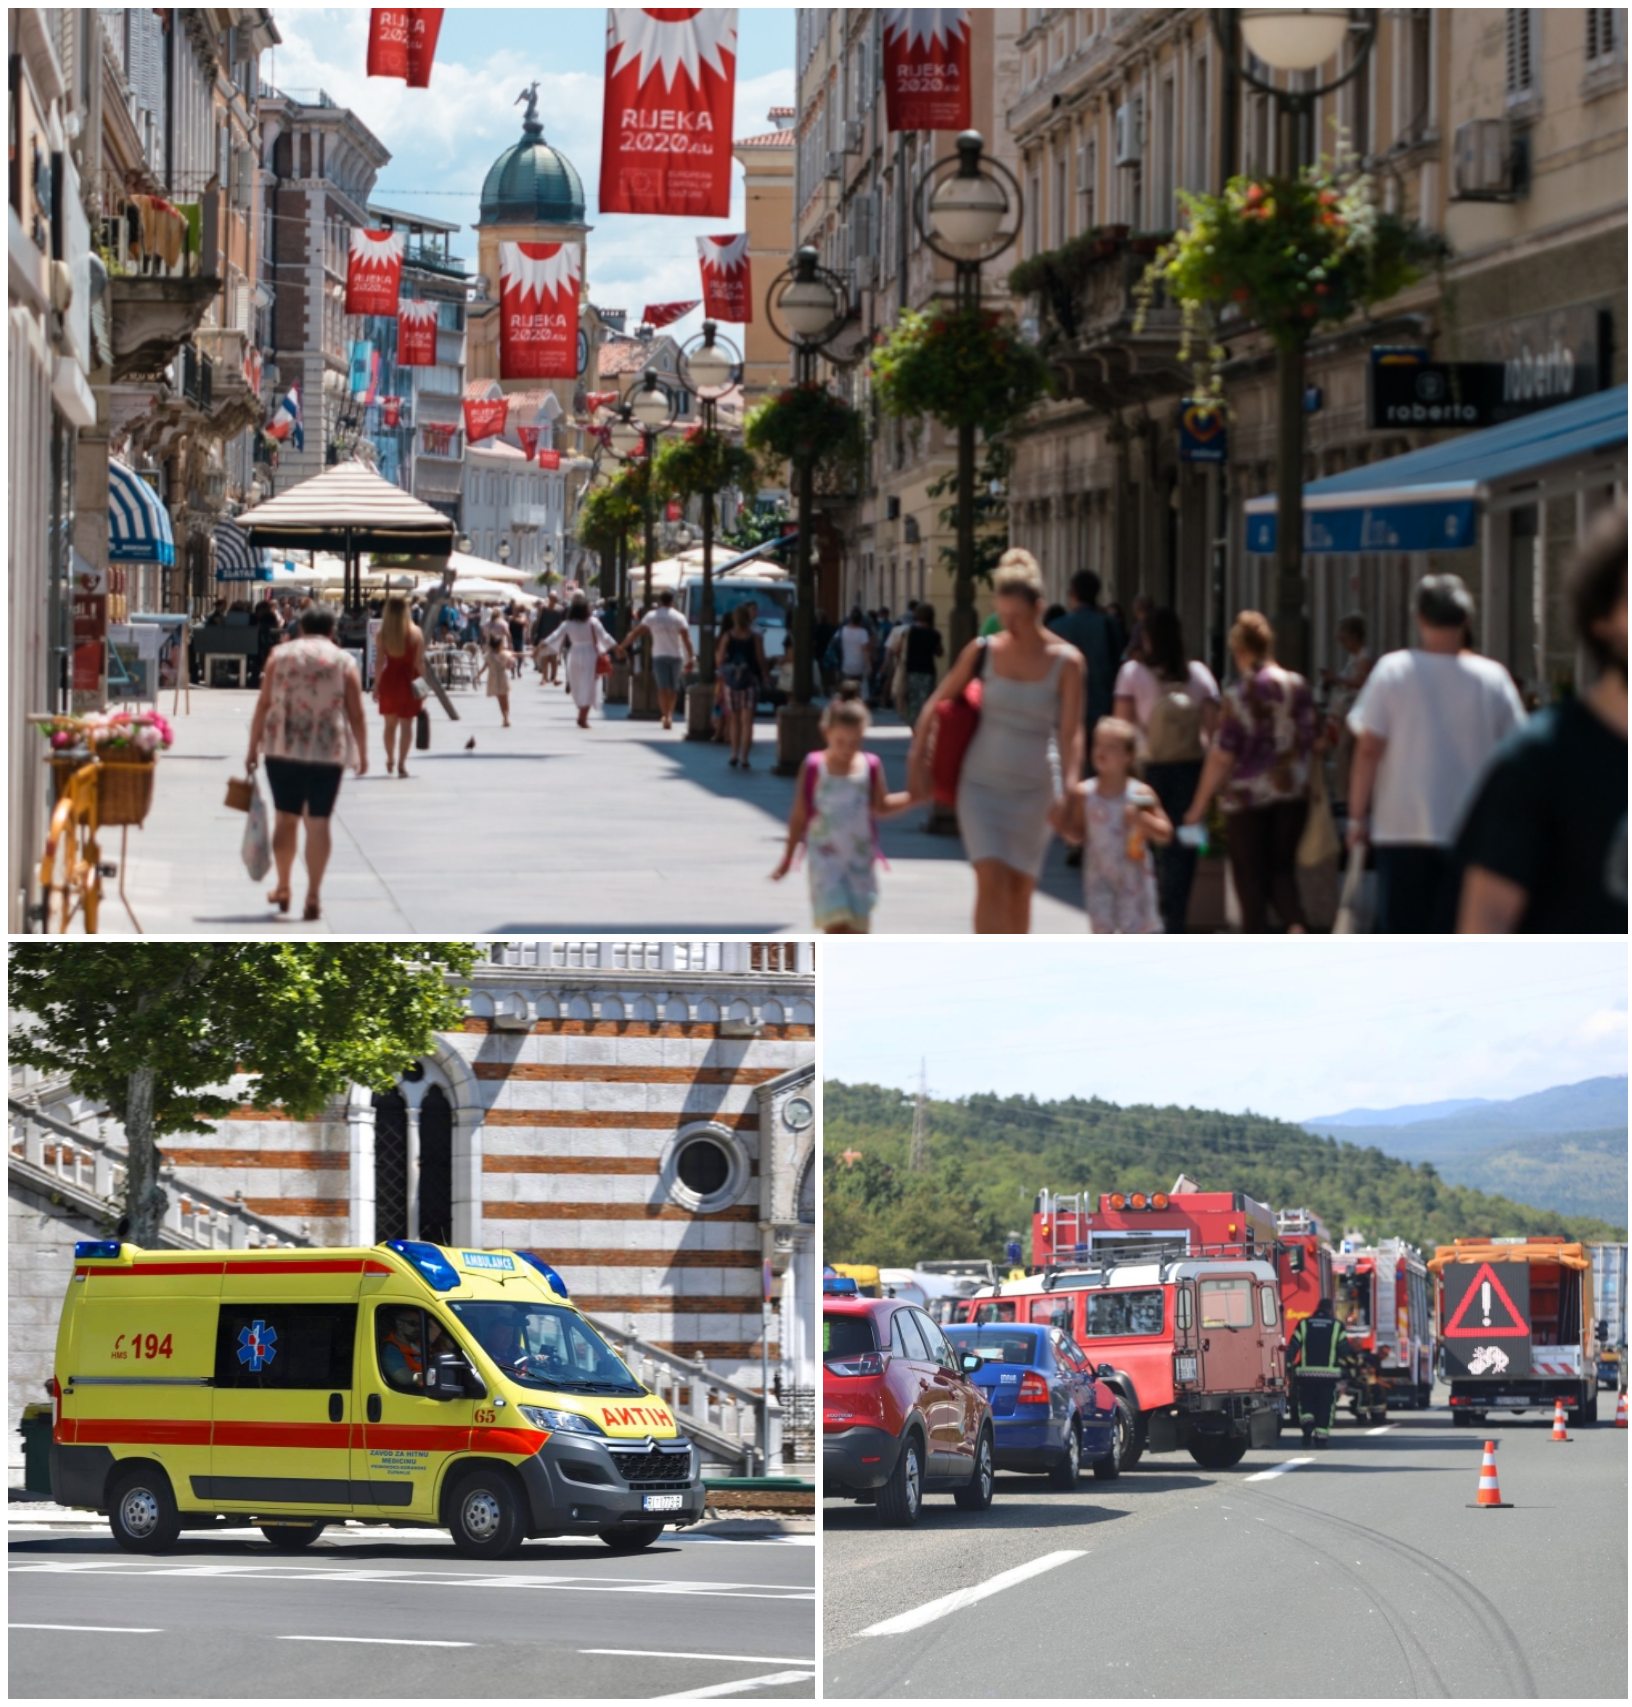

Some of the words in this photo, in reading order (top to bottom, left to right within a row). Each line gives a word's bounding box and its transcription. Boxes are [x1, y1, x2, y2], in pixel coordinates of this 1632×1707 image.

[896, 63, 959, 78] RIJEKA
[621, 108, 714, 132] RIJEKA
[619, 131, 714, 155] 2020.eu
[353, 274, 392, 286] RIJEKA
[510, 314, 567, 328] RIJEKA
[1387, 401, 1478, 422] roberto
[463, 1252, 514, 1270] AMBULANCE
[131, 1333, 173, 1359] 194
[474, 1409, 496, 1424] 65
[369, 1449, 393, 1457] ZAVOD
[395, 1450, 406, 1458] ZA
[382, 1457, 417, 1465] MEDICINU
